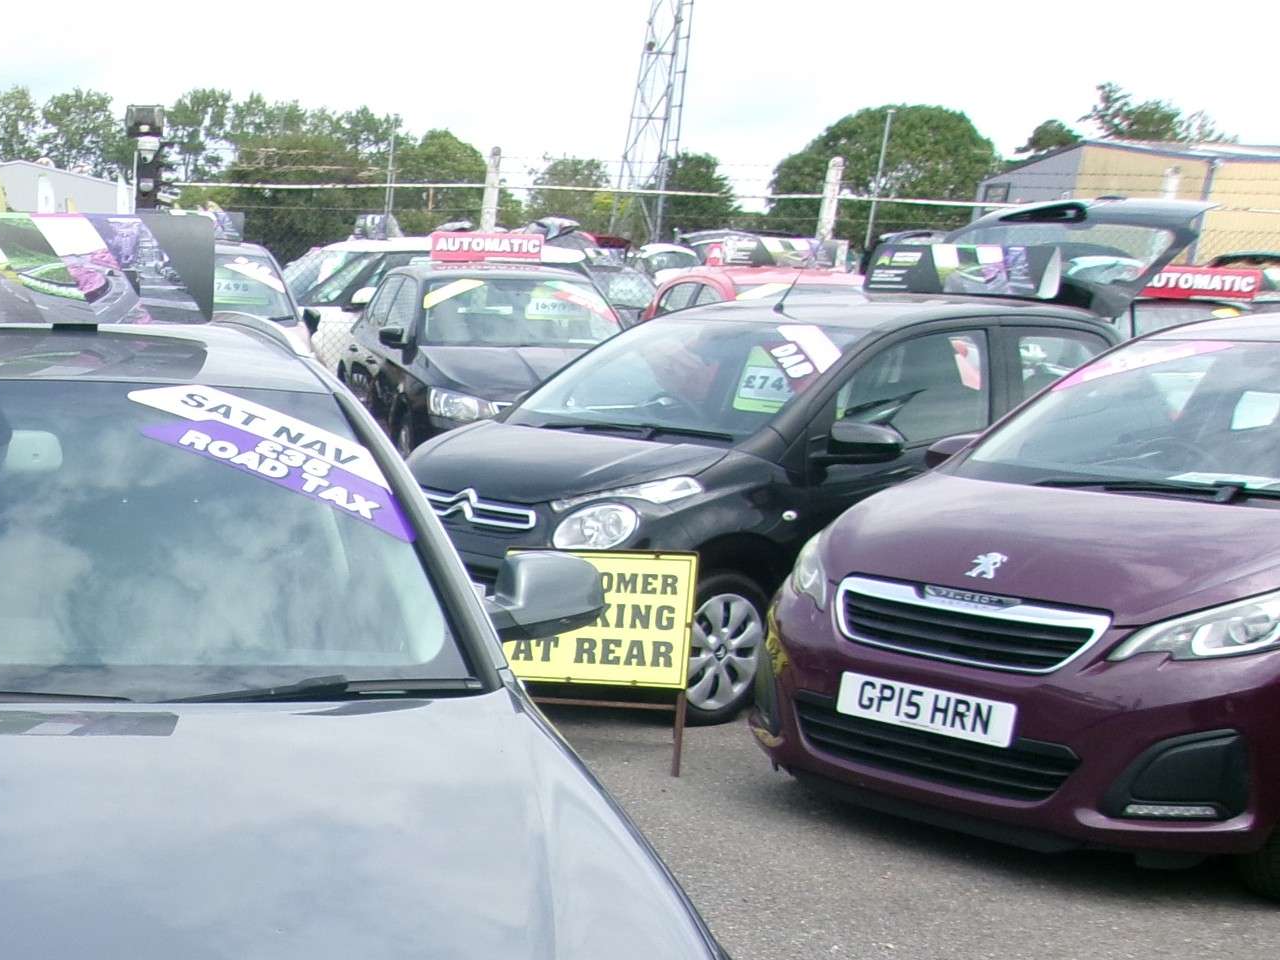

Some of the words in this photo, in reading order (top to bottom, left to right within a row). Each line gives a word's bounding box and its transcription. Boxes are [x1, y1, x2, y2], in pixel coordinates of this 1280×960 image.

[435, 237, 540, 253] AUTOMATIC
[1146, 272, 1255, 292] UTOMATIC
[769, 343, 814, 379] DAB
[743, 375, 786, 391] £74
[180, 393, 265, 426] SAT
[272, 425, 360, 464] NAV
[177, 429, 291, 479] ROAD
[301, 473, 382, 520] TAX
[599, 572, 678, 595] OMER
[588, 603, 675, 631] KING
[511, 636, 560, 662] AT
[573, 638, 673, 668] REAR
[857, 680, 924, 720] GP15
[929, 694, 993, 735] HRN
